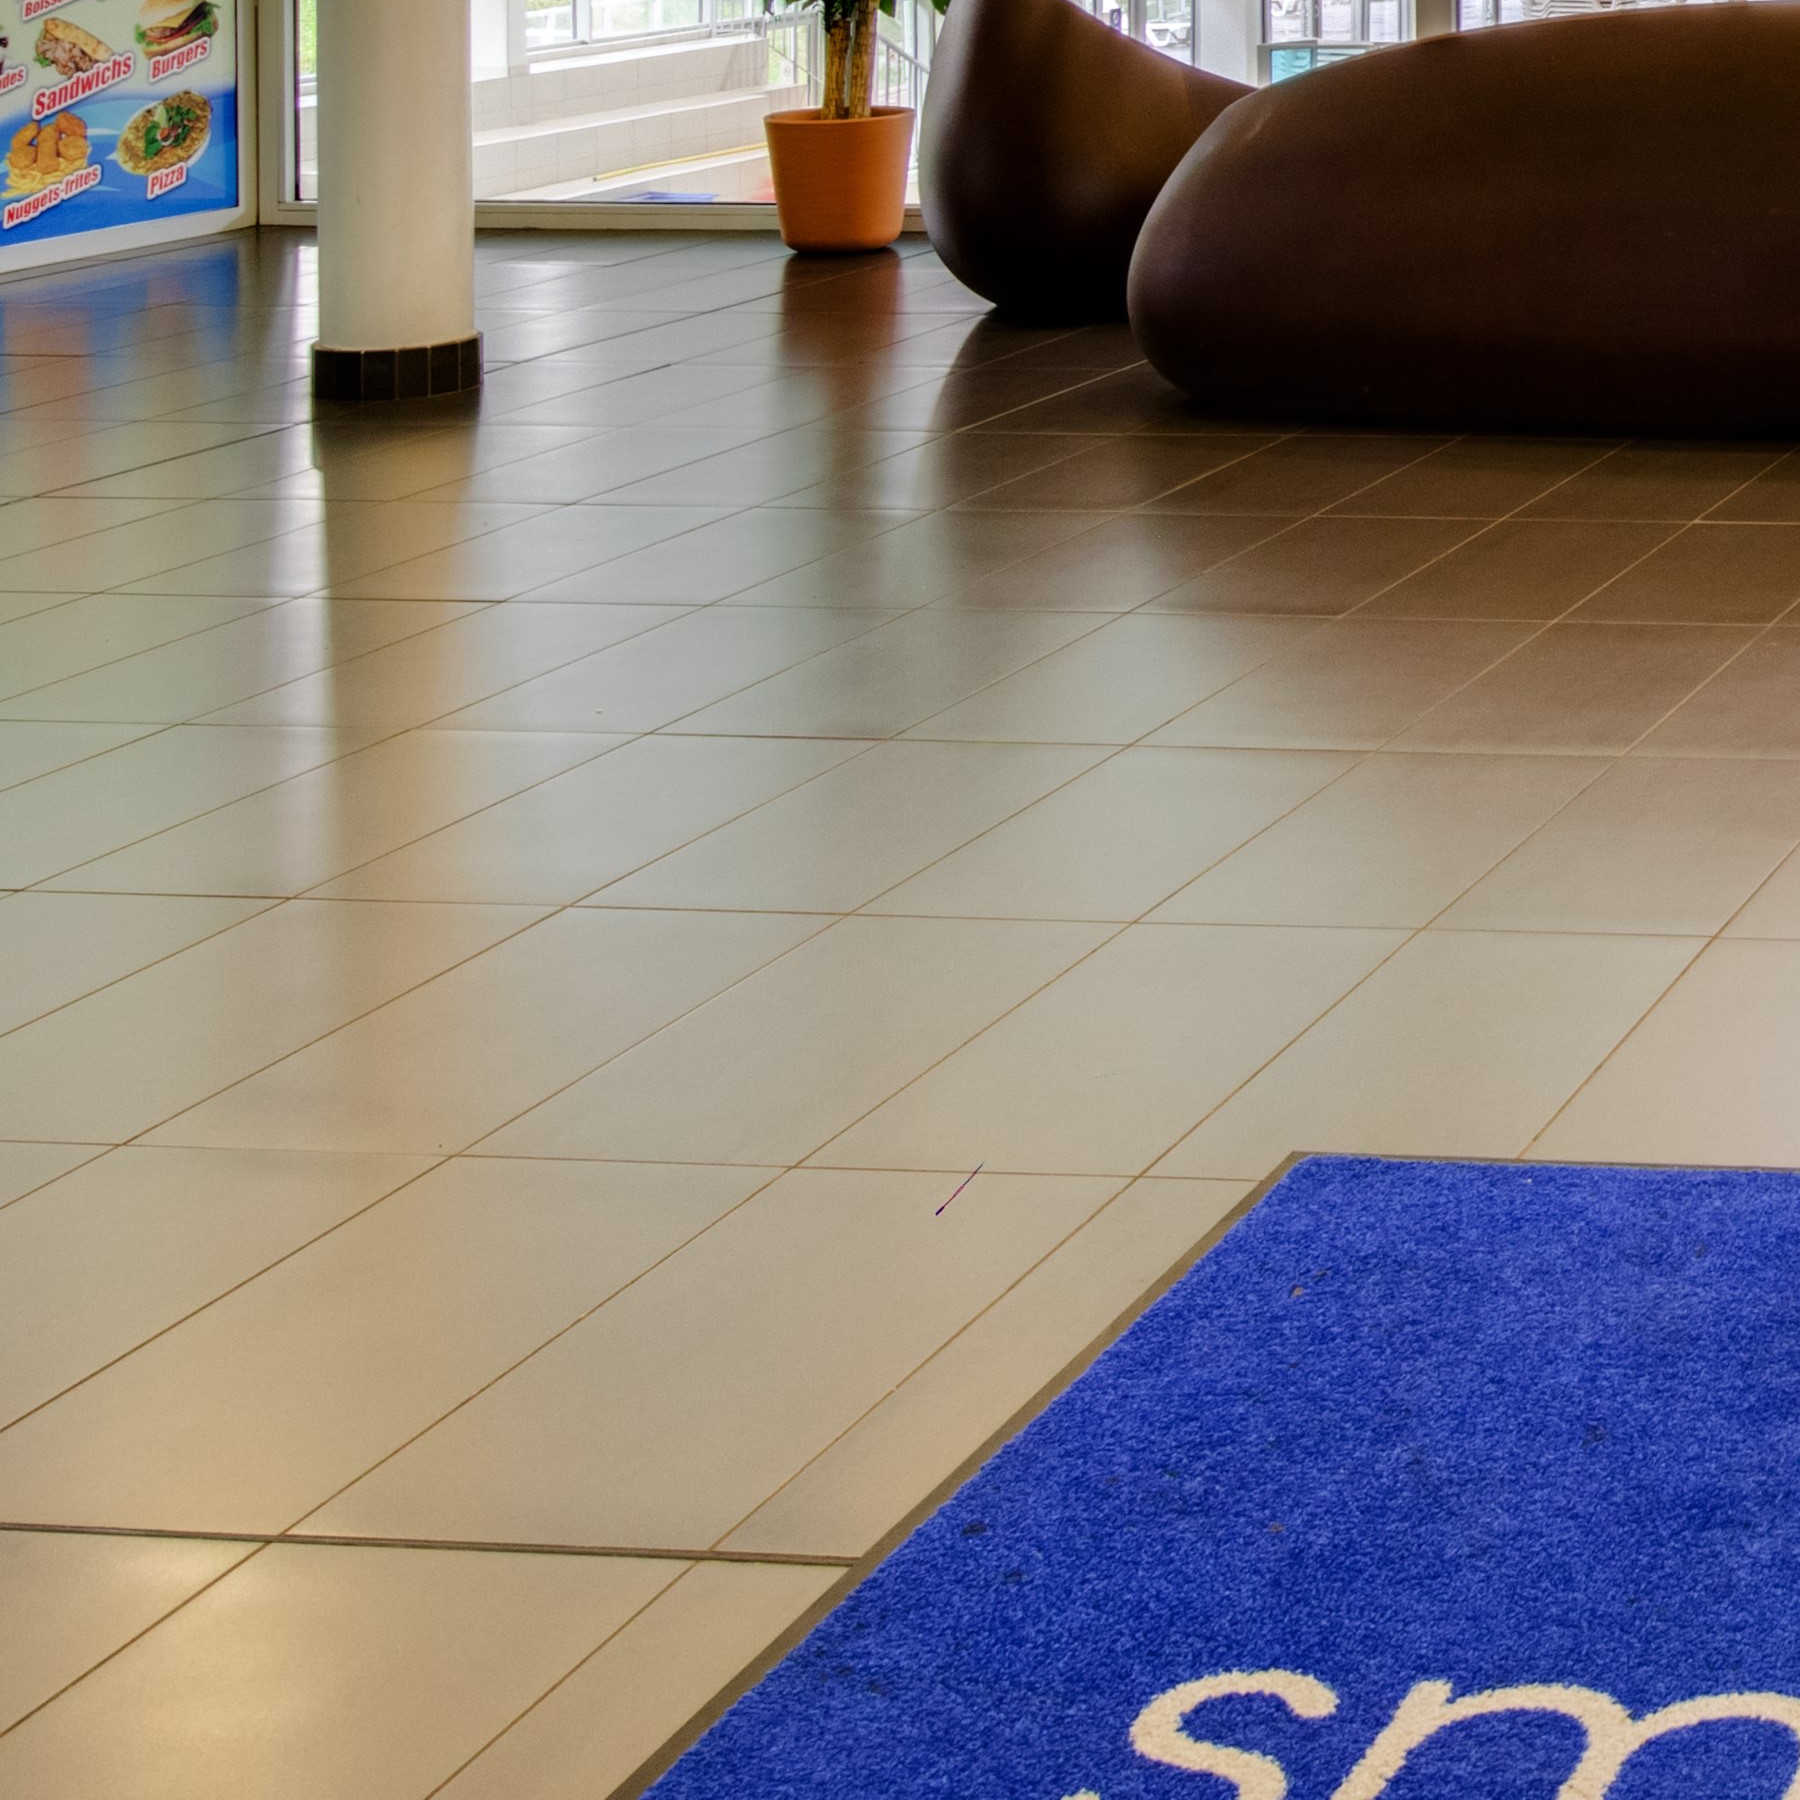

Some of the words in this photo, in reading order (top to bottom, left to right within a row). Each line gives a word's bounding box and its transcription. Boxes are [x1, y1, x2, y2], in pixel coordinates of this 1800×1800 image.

[151, 40, 208, 78] Burgers
[35, 57, 132, 116] Sandwichs
[6, 167, 98, 225] Nuggets-frites
[150, 165, 184, 195] Pizza
